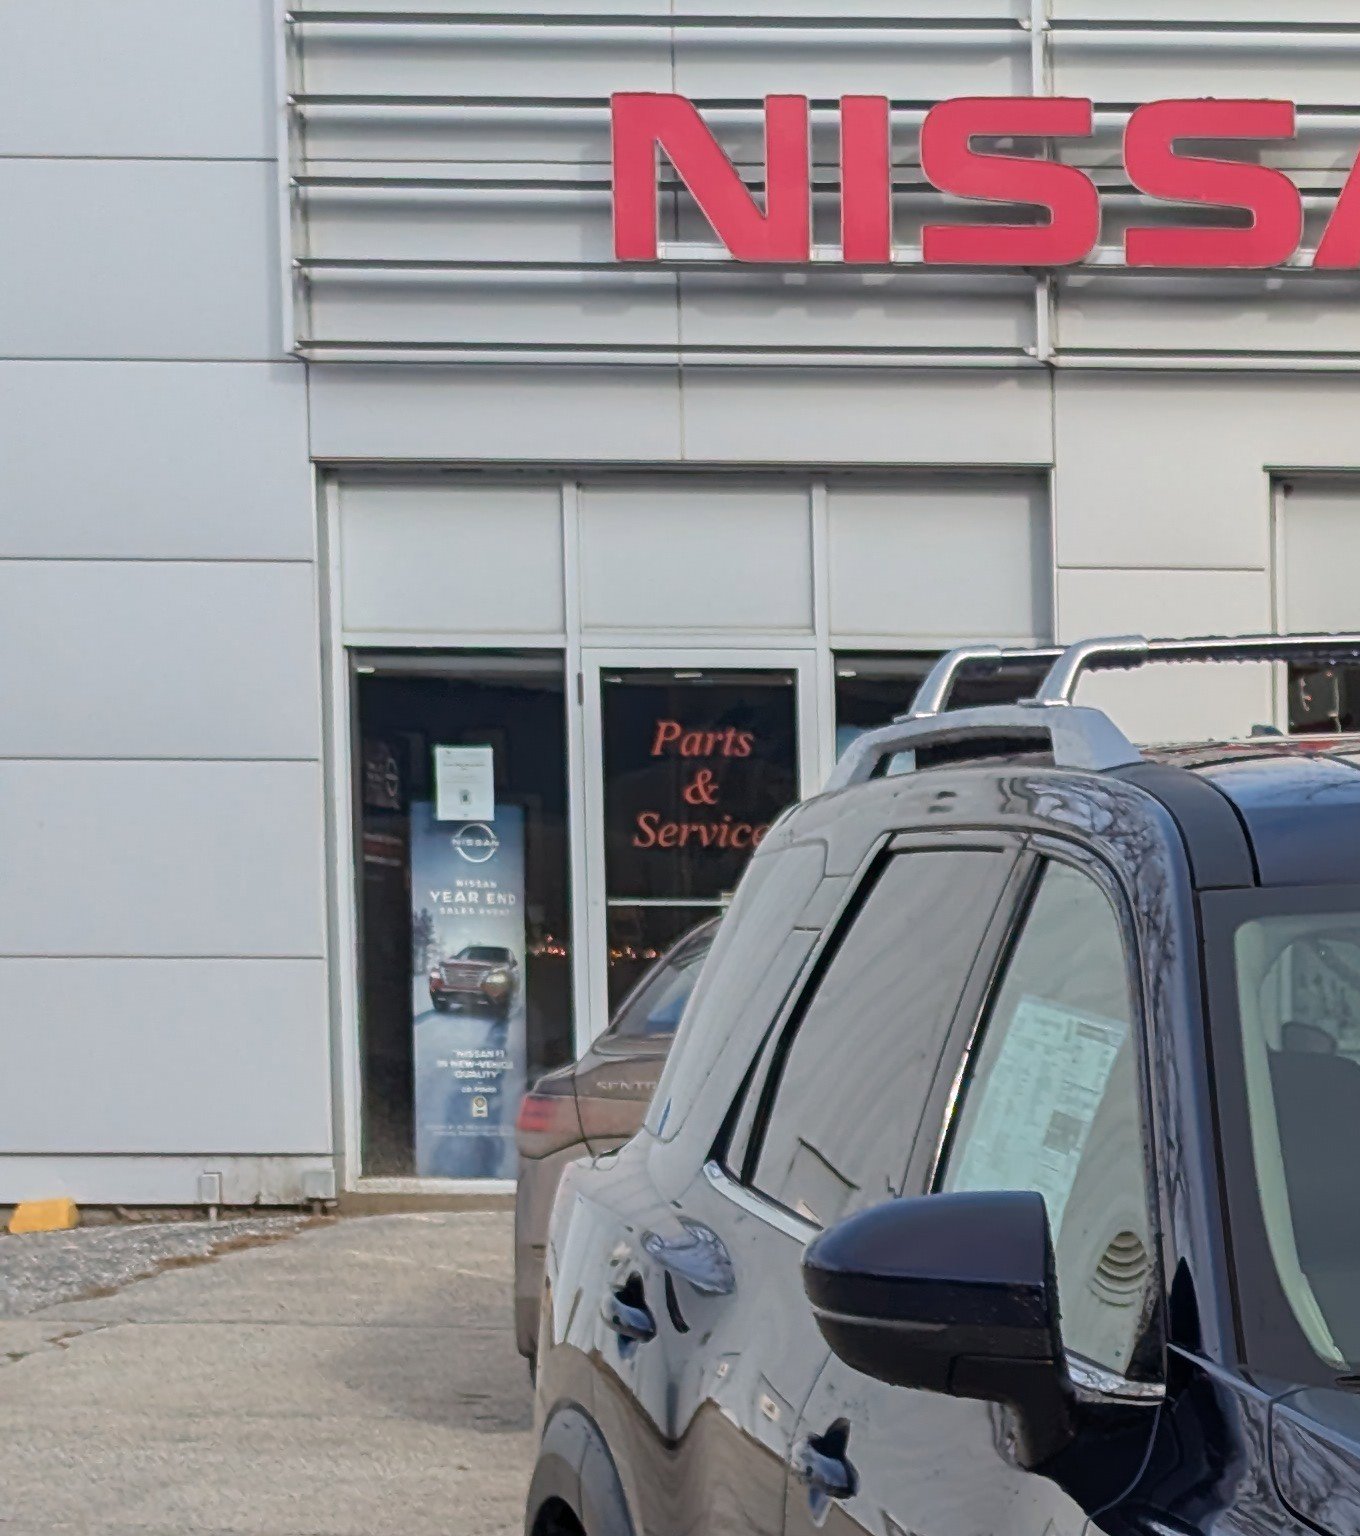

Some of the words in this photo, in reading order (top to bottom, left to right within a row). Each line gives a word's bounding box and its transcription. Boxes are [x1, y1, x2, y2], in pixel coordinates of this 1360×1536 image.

[651, 719, 755, 757] Parts
[683, 768, 719, 805] &
[430, 891, 479, 904] YEAR
[486, 893, 516, 906] END
